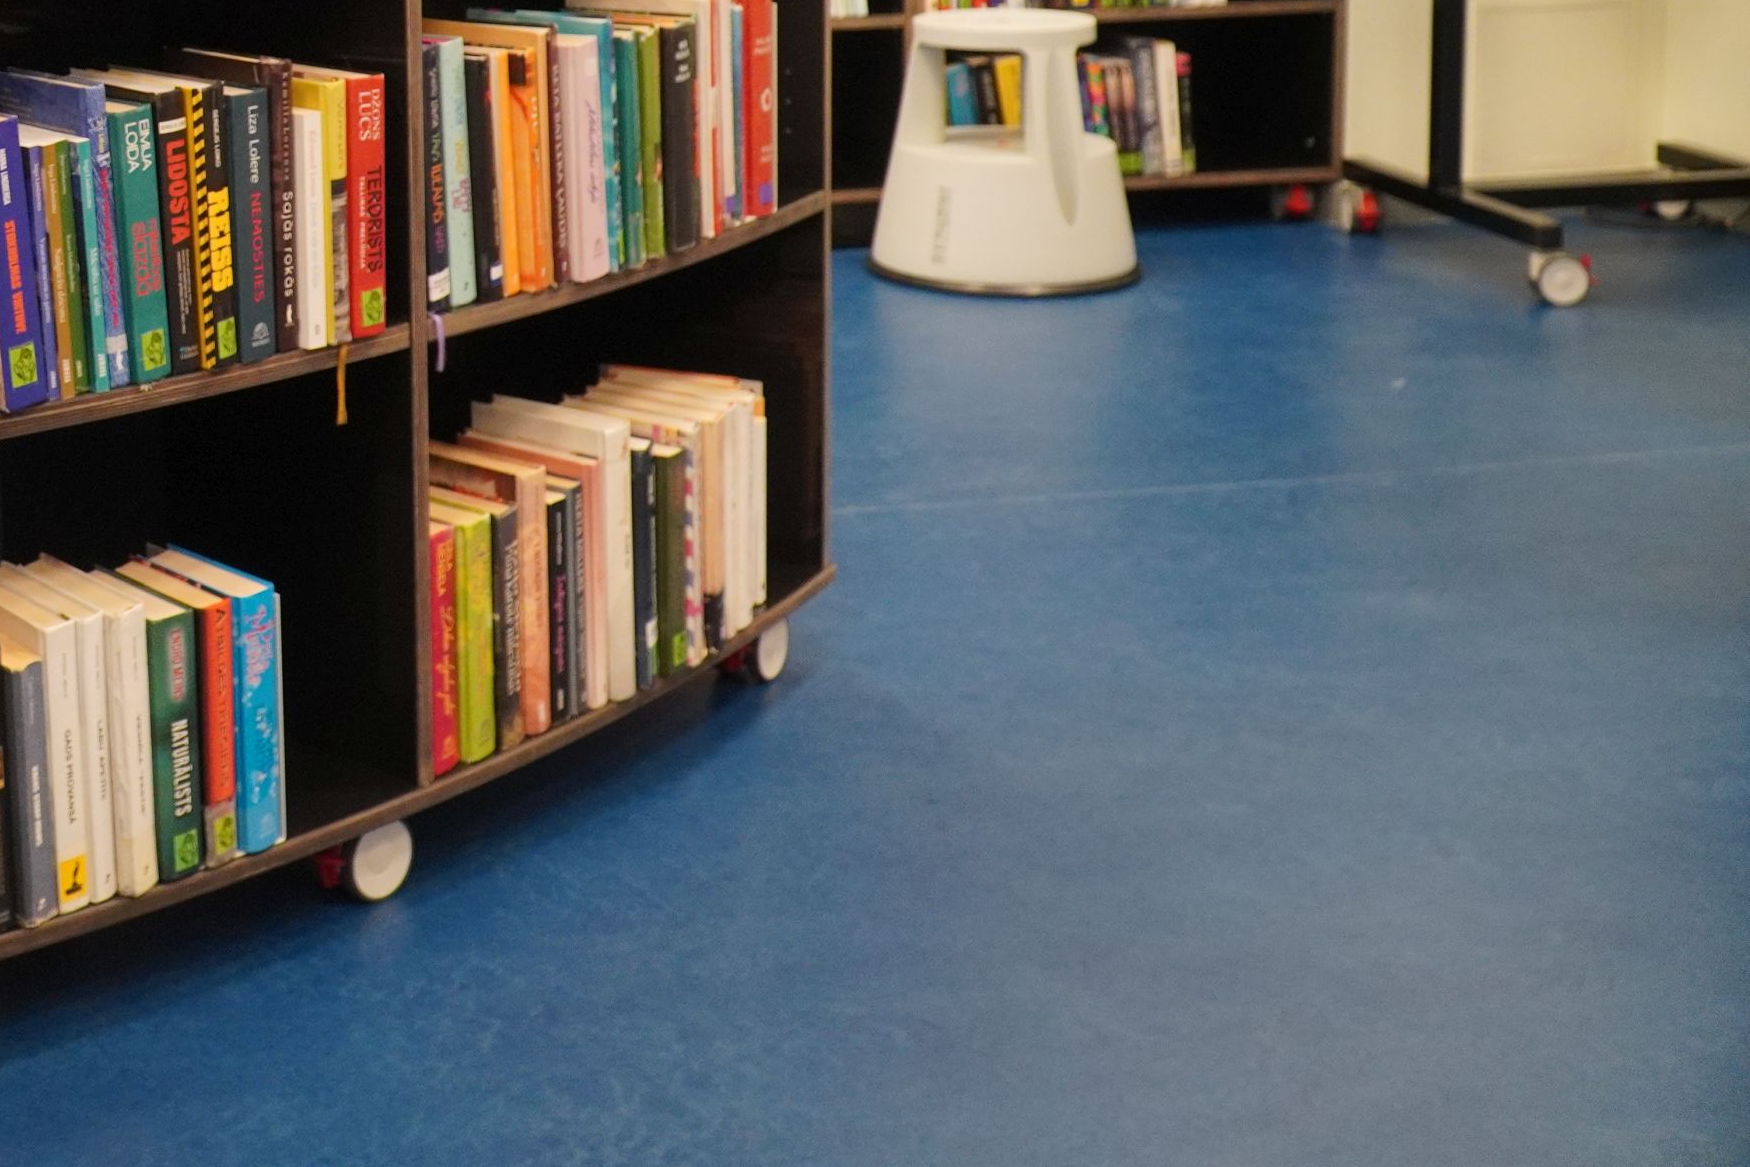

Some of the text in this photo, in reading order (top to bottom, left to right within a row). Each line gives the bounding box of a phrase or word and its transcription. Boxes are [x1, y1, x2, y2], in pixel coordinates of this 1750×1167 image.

[124, 122, 139, 173] LOIDA
[358, 92, 370, 141] LUCS
[371, 88, 382, 141] DŽONS
[165, 139, 189, 245] LIDOSTA
[248, 139, 261, 183] Lolere
[3, 220, 22, 289] STOKHOLMAS
[207, 187, 233, 292] REISS
[250, 190, 265, 302] NEMOSTIES
[366, 165, 383, 273] TERORISTS
[170, 719, 193, 817] NATURĀLISTS
